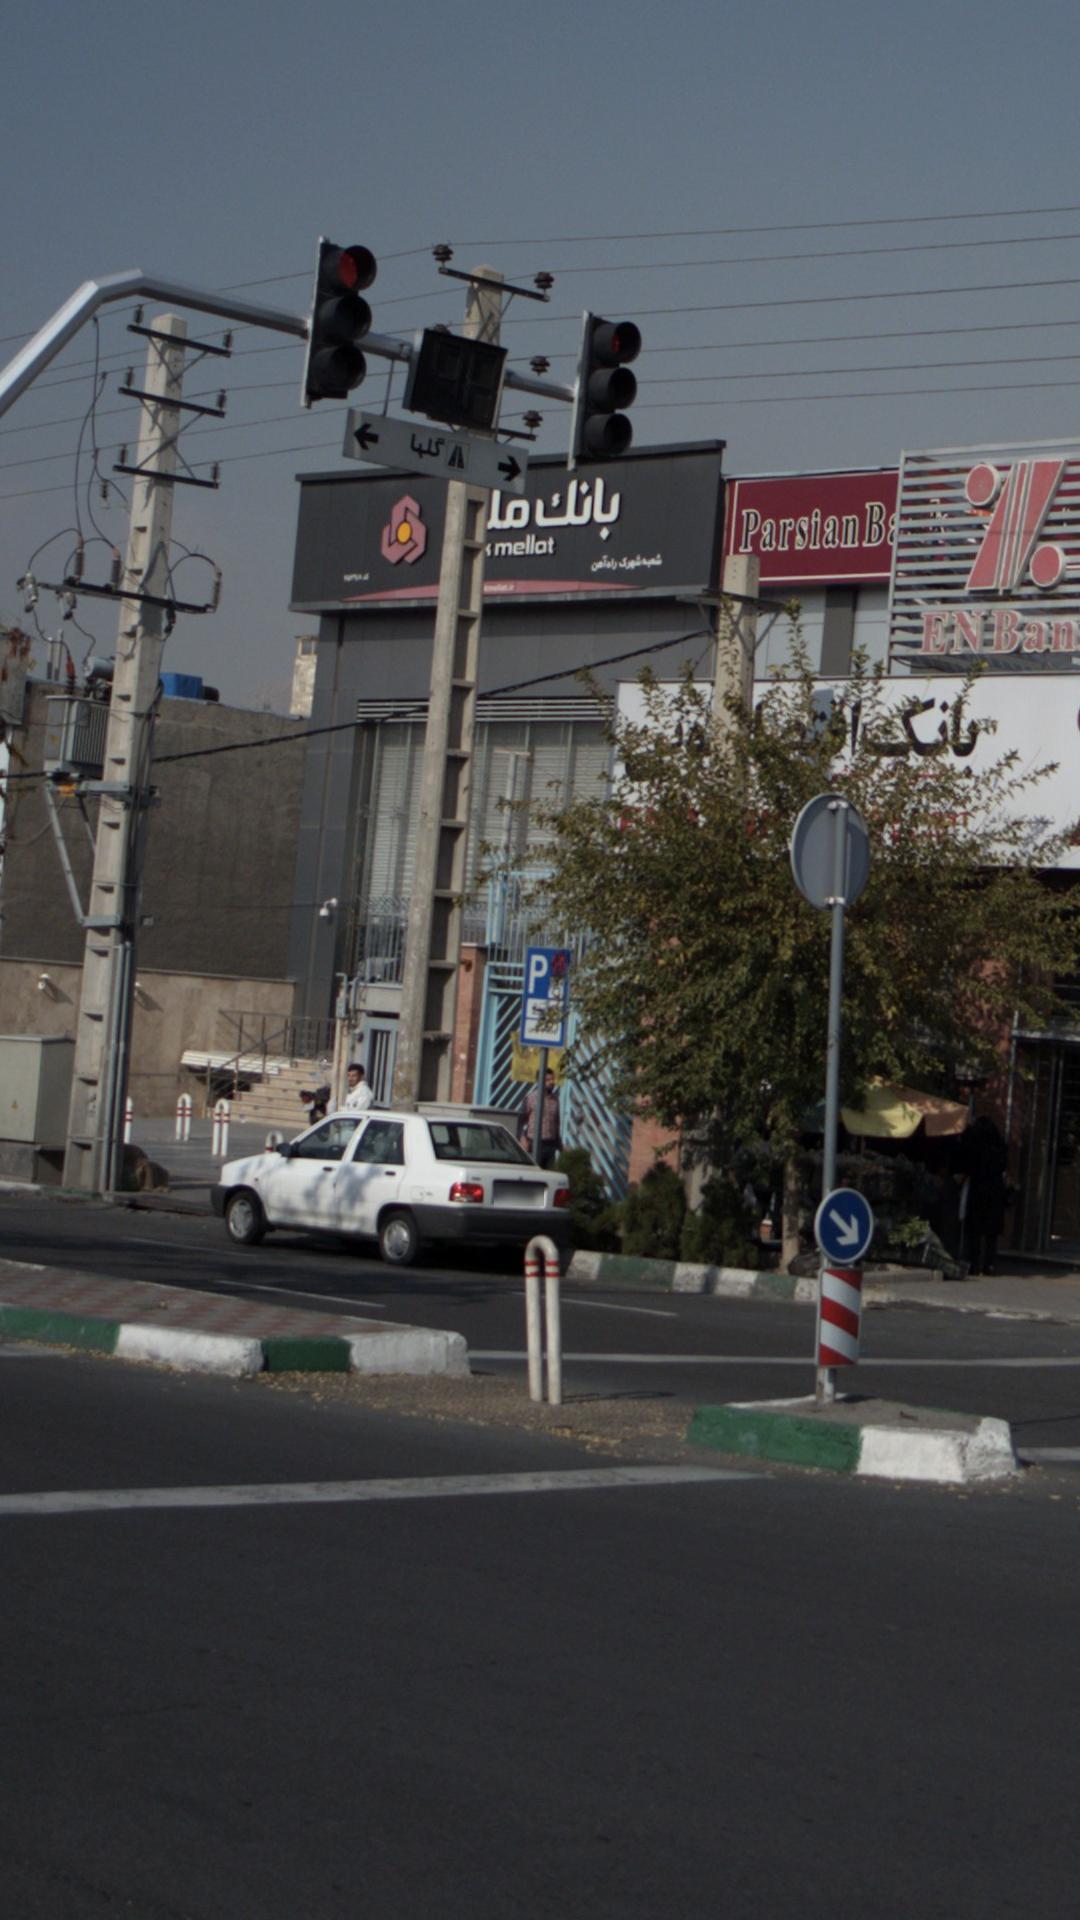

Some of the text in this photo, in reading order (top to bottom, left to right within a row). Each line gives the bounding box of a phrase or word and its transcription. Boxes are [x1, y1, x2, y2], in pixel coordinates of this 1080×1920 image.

[487, 489, 530, 530] مل
[495, 534, 555, 557] mellat
[739, 508, 859, 552] Parsian
[529, 954, 548, 994] P
